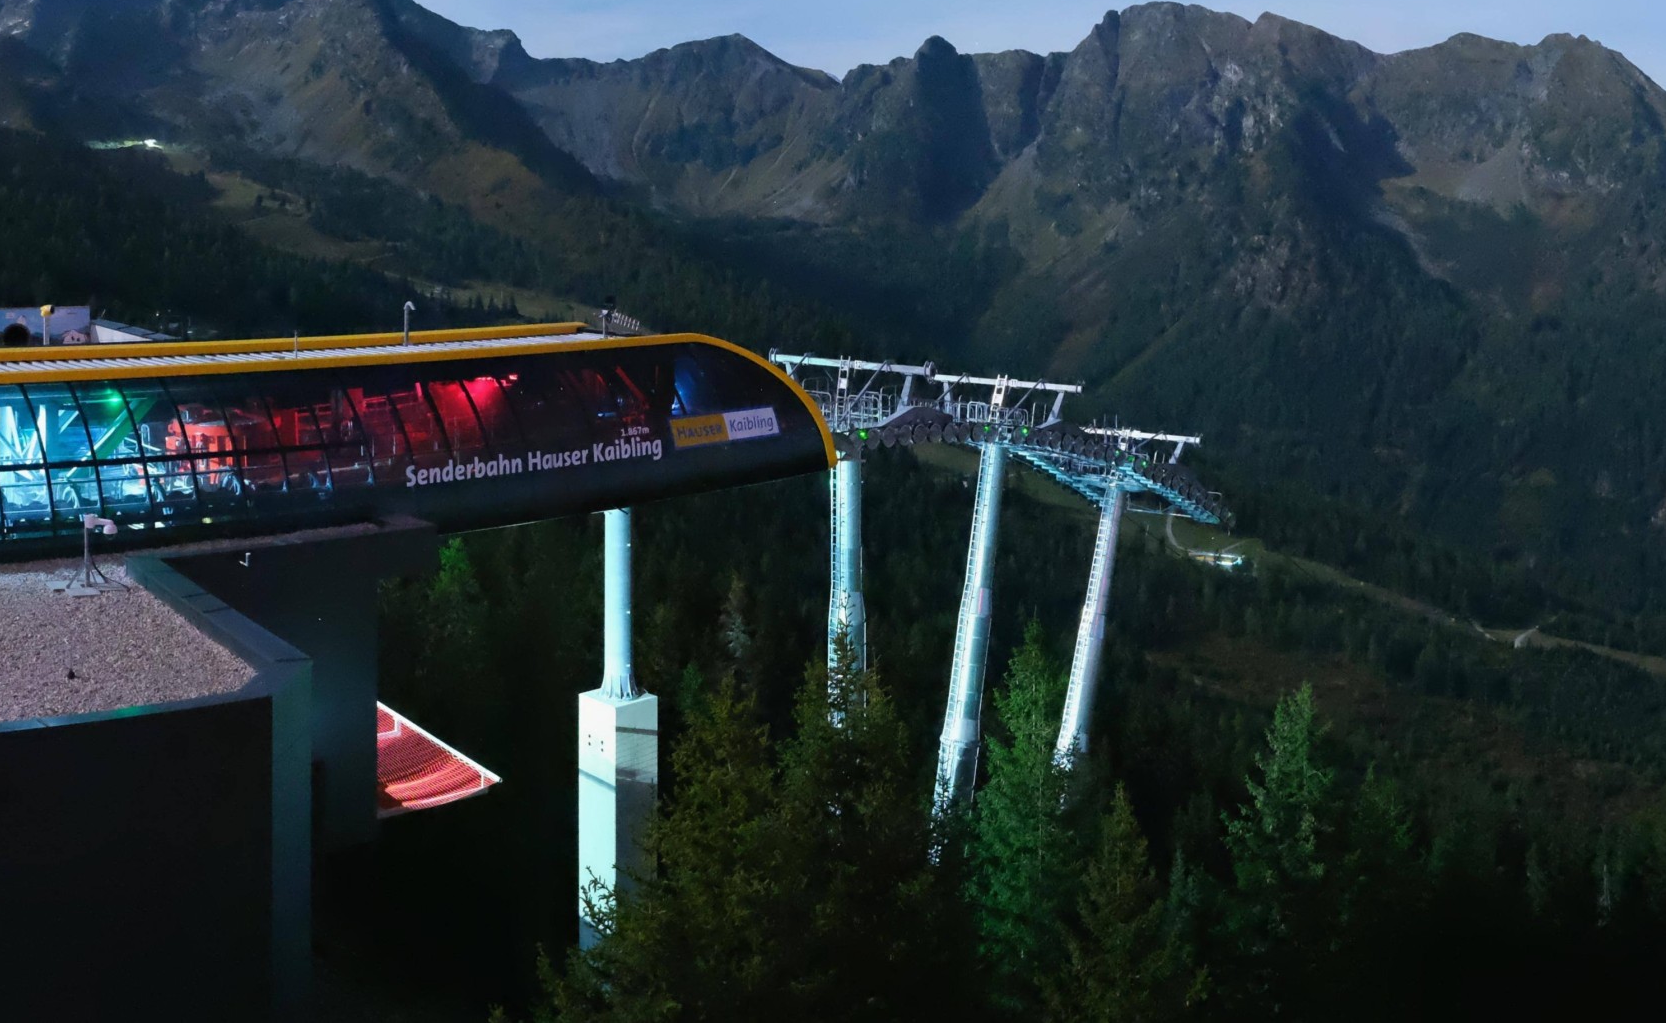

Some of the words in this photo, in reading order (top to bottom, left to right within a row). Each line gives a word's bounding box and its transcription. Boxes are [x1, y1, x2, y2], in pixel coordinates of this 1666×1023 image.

[729, 416, 773, 433] Kaibling
[405, 453, 523, 488] Senderbahn
[527, 448, 588, 472] Hauser
[593, 436, 662, 463] Kaibling
